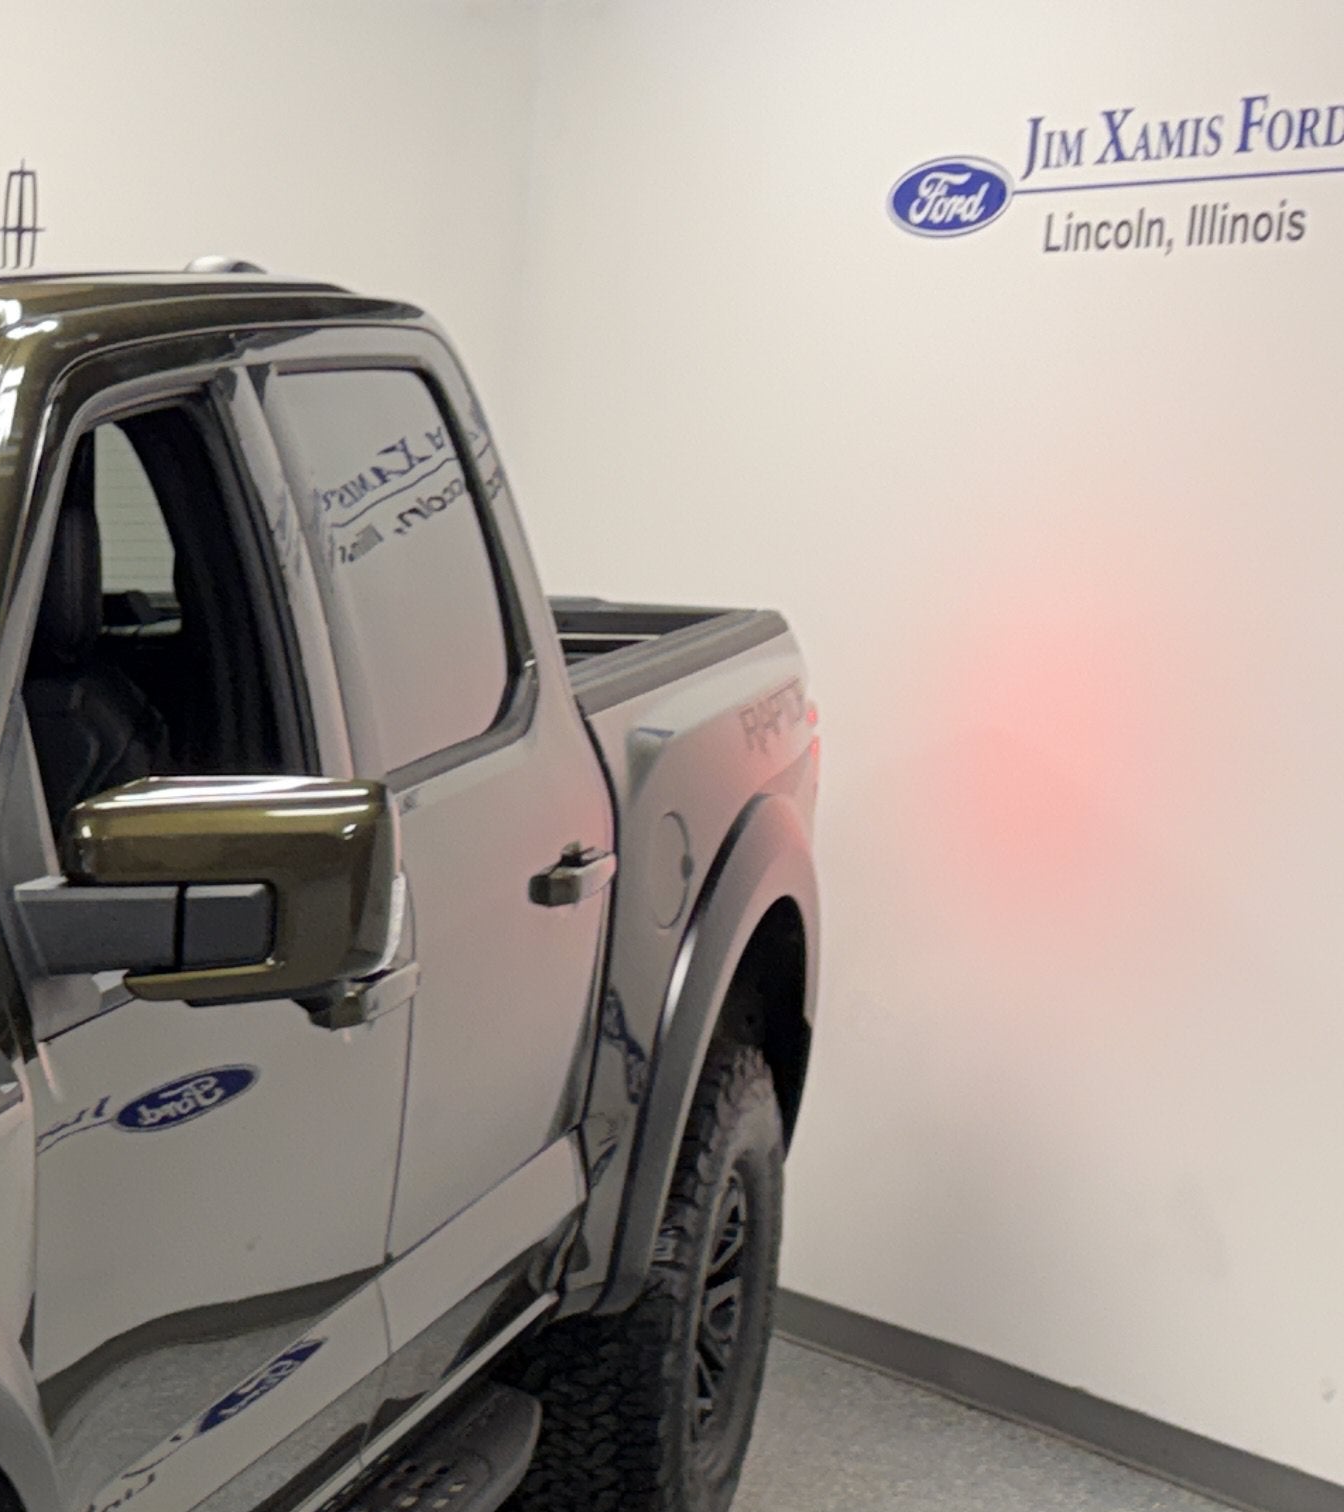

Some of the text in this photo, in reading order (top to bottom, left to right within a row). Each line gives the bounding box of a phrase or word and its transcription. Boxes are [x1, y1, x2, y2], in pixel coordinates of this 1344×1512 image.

[1021, 94, 1344, 181] JIM XAMIS FORD
[1043, 198, 1307, 256] Lincoln, Illinois
